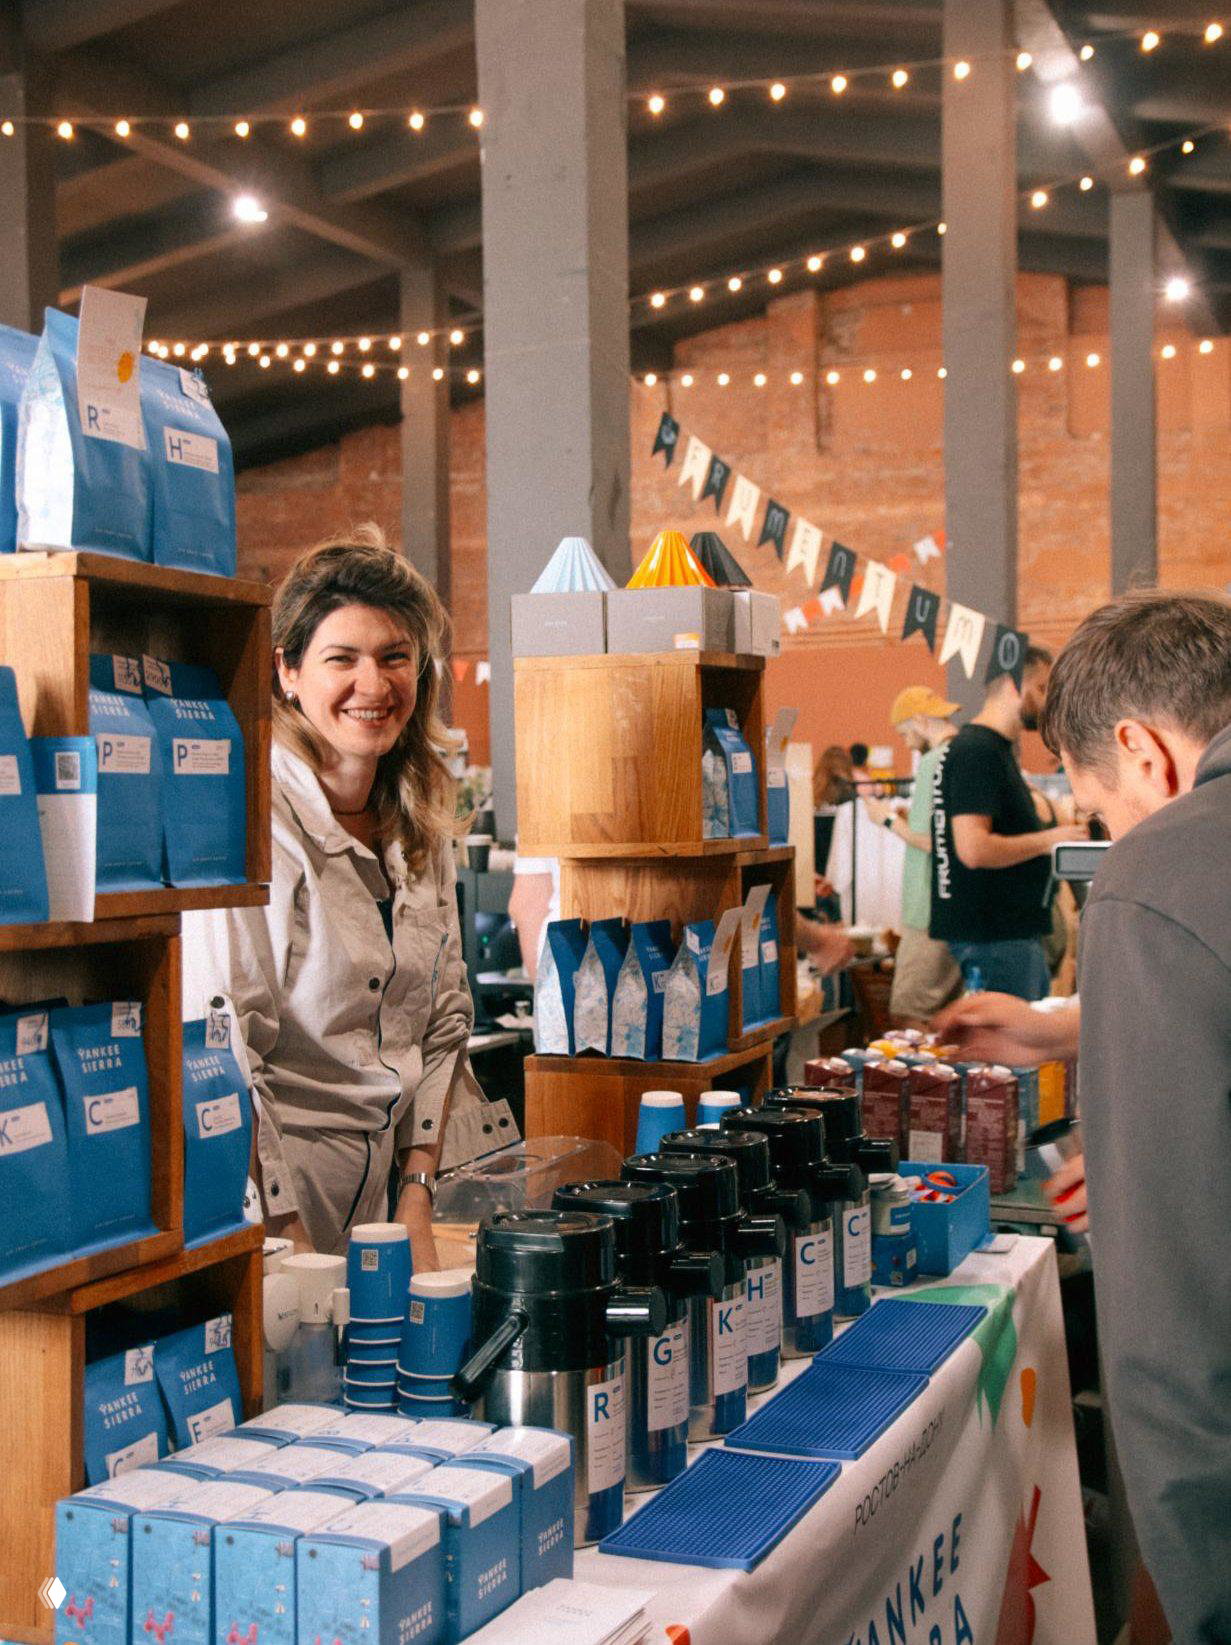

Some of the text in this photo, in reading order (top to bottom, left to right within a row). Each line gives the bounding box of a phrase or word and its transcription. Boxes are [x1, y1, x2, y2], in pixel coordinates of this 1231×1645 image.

[87, 404, 101, 430] R
[168, 436, 183, 460] H
[102, 740, 113, 765] P
[177, 744, 188, 767] P
[77, 1044, 121, 1060] YANKEE
[186, 1055, 221, 1072] YANKEE
[82, 1057, 123, 1074] SIERRA
[191, 1066, 226, 1082] SIERRA
[88, 1101, 103, 1125] C
[201, 1108, 212, 1131] C
[847, 1215, 860, 1237] C
[800, 1242, 816, 1266] C
[747, 1275, 763, 1302] H
[718, 1306, 734, 1335] K
[653, 1337, 673, 1366] G
[179, 1361, 215, 1384] YANKEE
[183, 1373, 217, 1395] SIERRA
[98, 1391, 139, 1416] YANKEE
[593, 1391, 610, 1423] R
[103, 1404, 143, 1429] SIERRA
[538, 1518, 564, 1544] YANKEE
[538, 1530, 564, 1556] SIERRA
[478, 1557, 507, 1586] YANKEE
[478, 1571, 507, 1600] SIERRA
[398, 1600, 432, 1632] YANKEE
[400, 1614, 433, 1645] SIERRA
